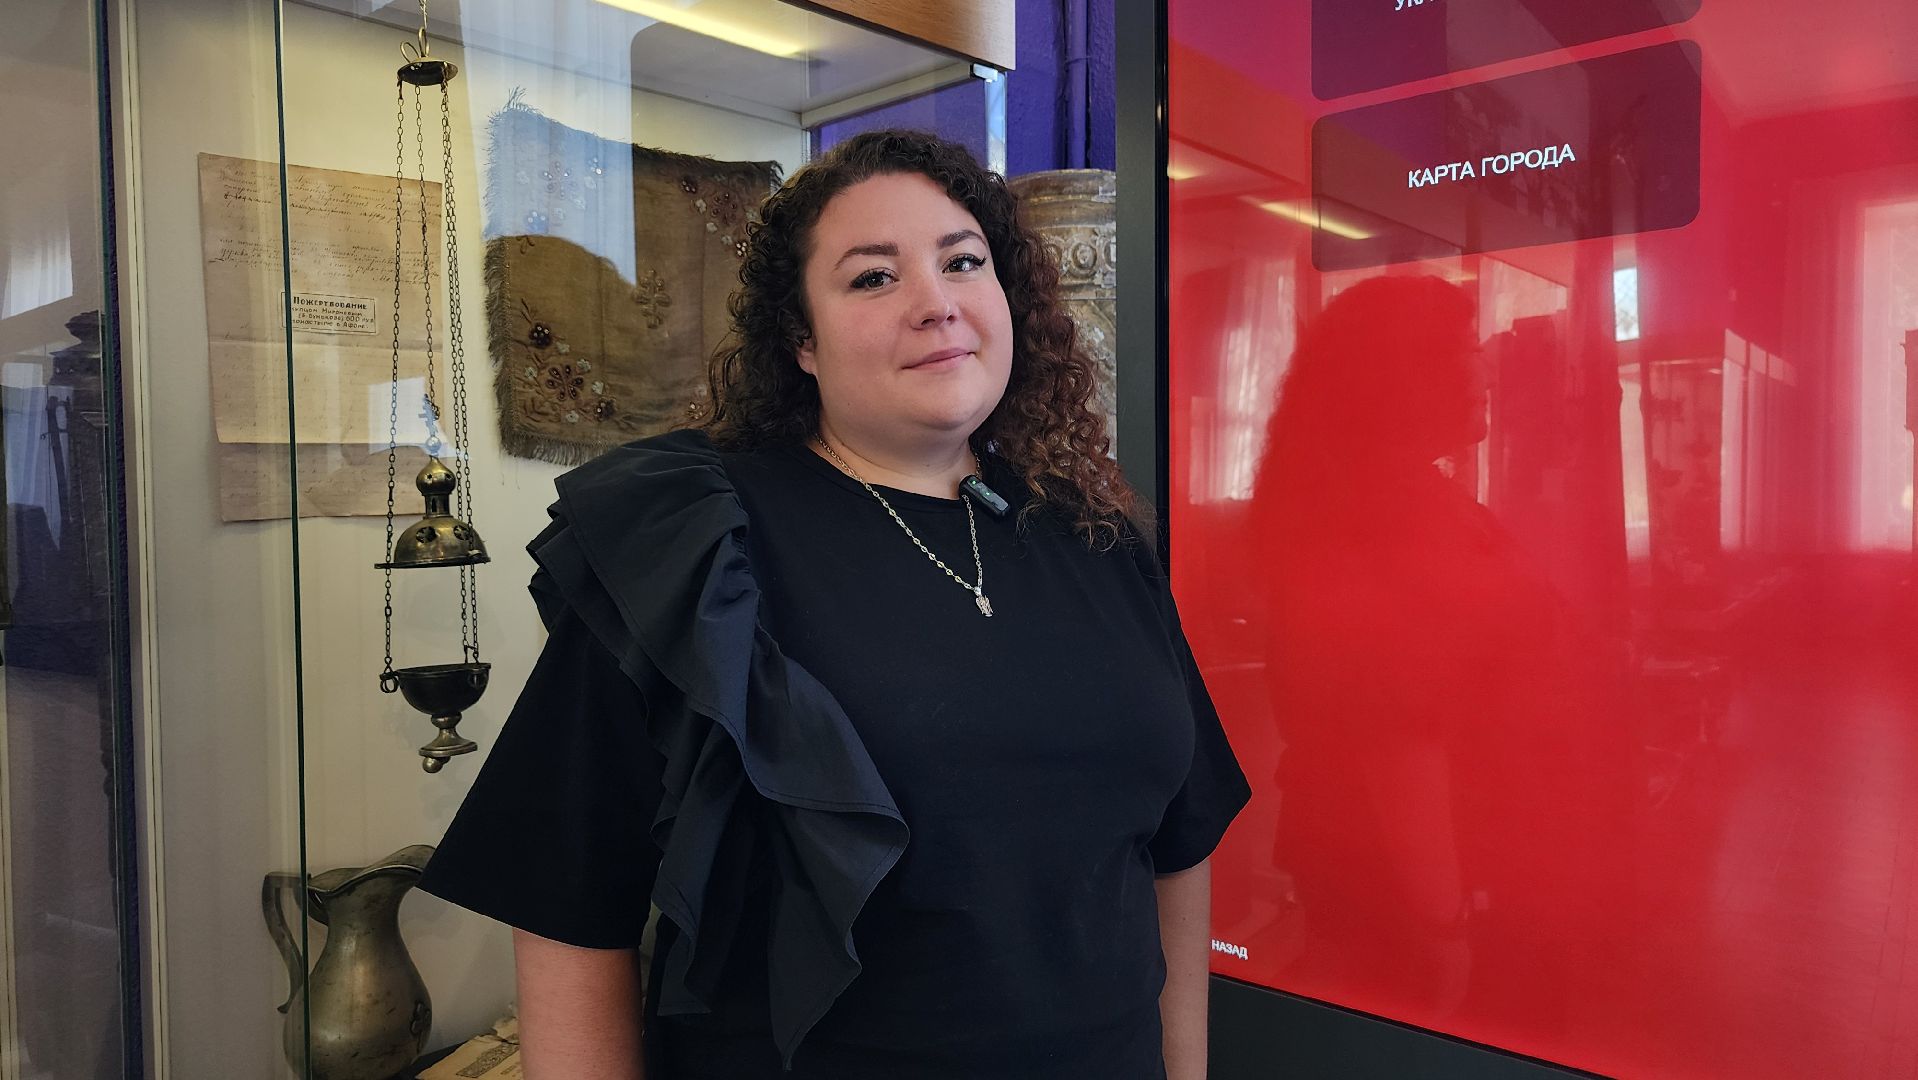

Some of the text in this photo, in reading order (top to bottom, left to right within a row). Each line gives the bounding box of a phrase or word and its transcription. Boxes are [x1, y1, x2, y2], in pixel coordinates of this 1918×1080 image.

[1407, 143, 1576, 188] КАРТА ГОРОДА
[1211, 939, 1248, 961] НАЗАД
